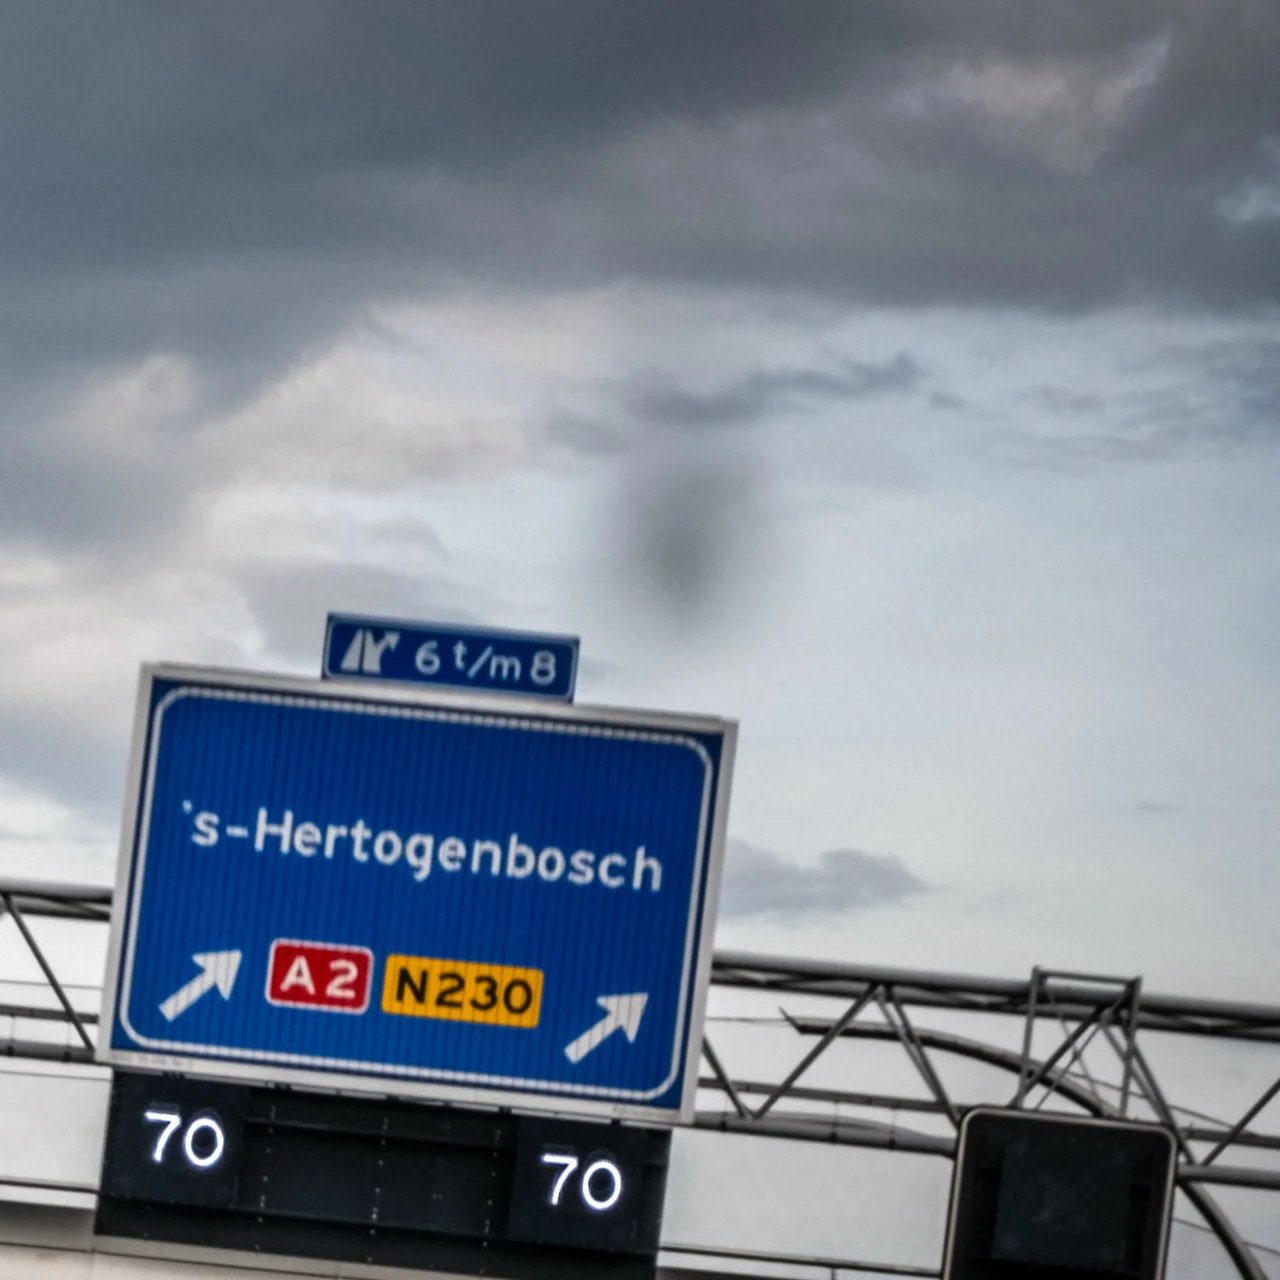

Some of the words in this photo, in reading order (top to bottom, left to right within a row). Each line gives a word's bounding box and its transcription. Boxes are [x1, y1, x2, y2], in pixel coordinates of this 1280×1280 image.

[414, 640, 441, 675] 6
[453, 640, 522, 681] t/m
[529, 650, 557, 685] 8
[183, 800, 662, 891] 's-Hertogenbosch
[280, 956, 359, 999] A2
[396, 967, 534, 1016] N230
[144, 1111, 225, 1168] 70
[542, 1153, 623, 1210] 70
